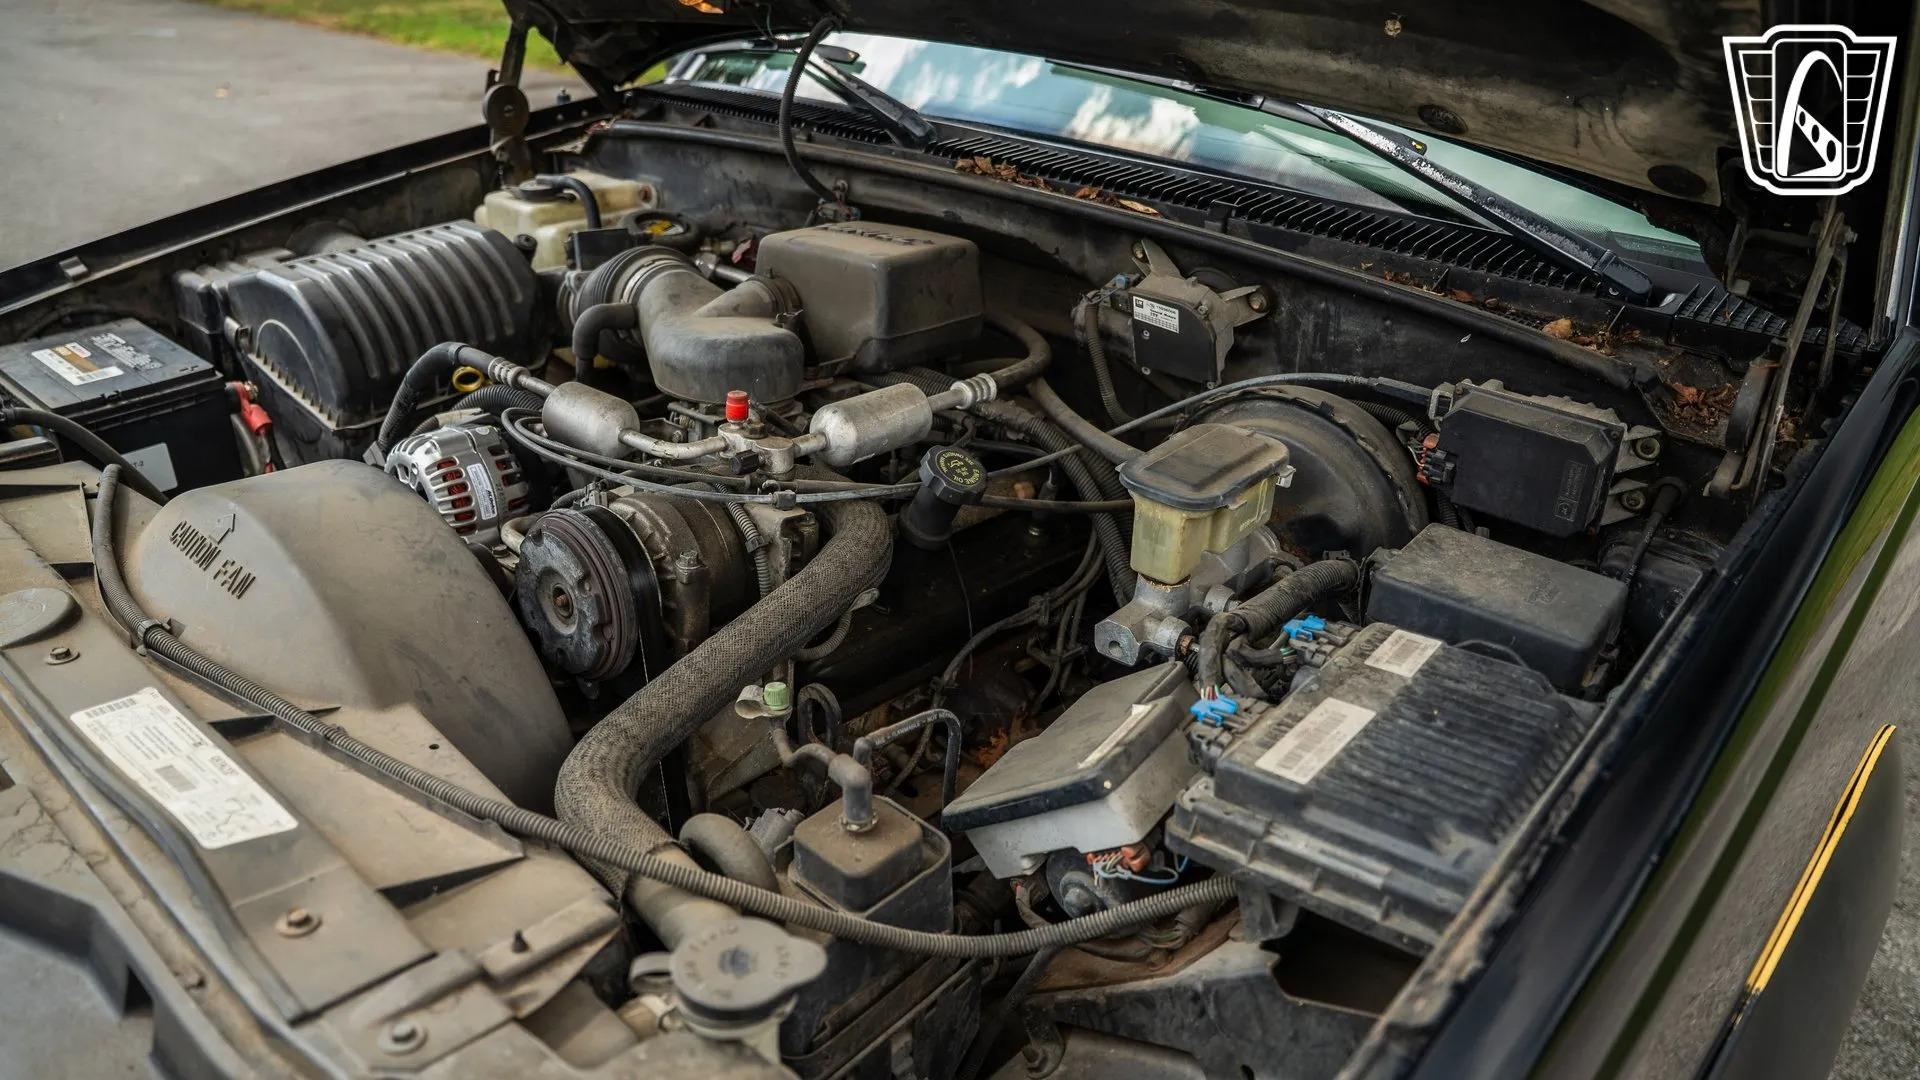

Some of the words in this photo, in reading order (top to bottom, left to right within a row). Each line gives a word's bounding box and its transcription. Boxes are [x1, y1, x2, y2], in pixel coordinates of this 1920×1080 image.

[953, 474, 964, 483] OIL
[169, 520, 222, 572] CAUTION
[213, 559, 257, 600] FAN
